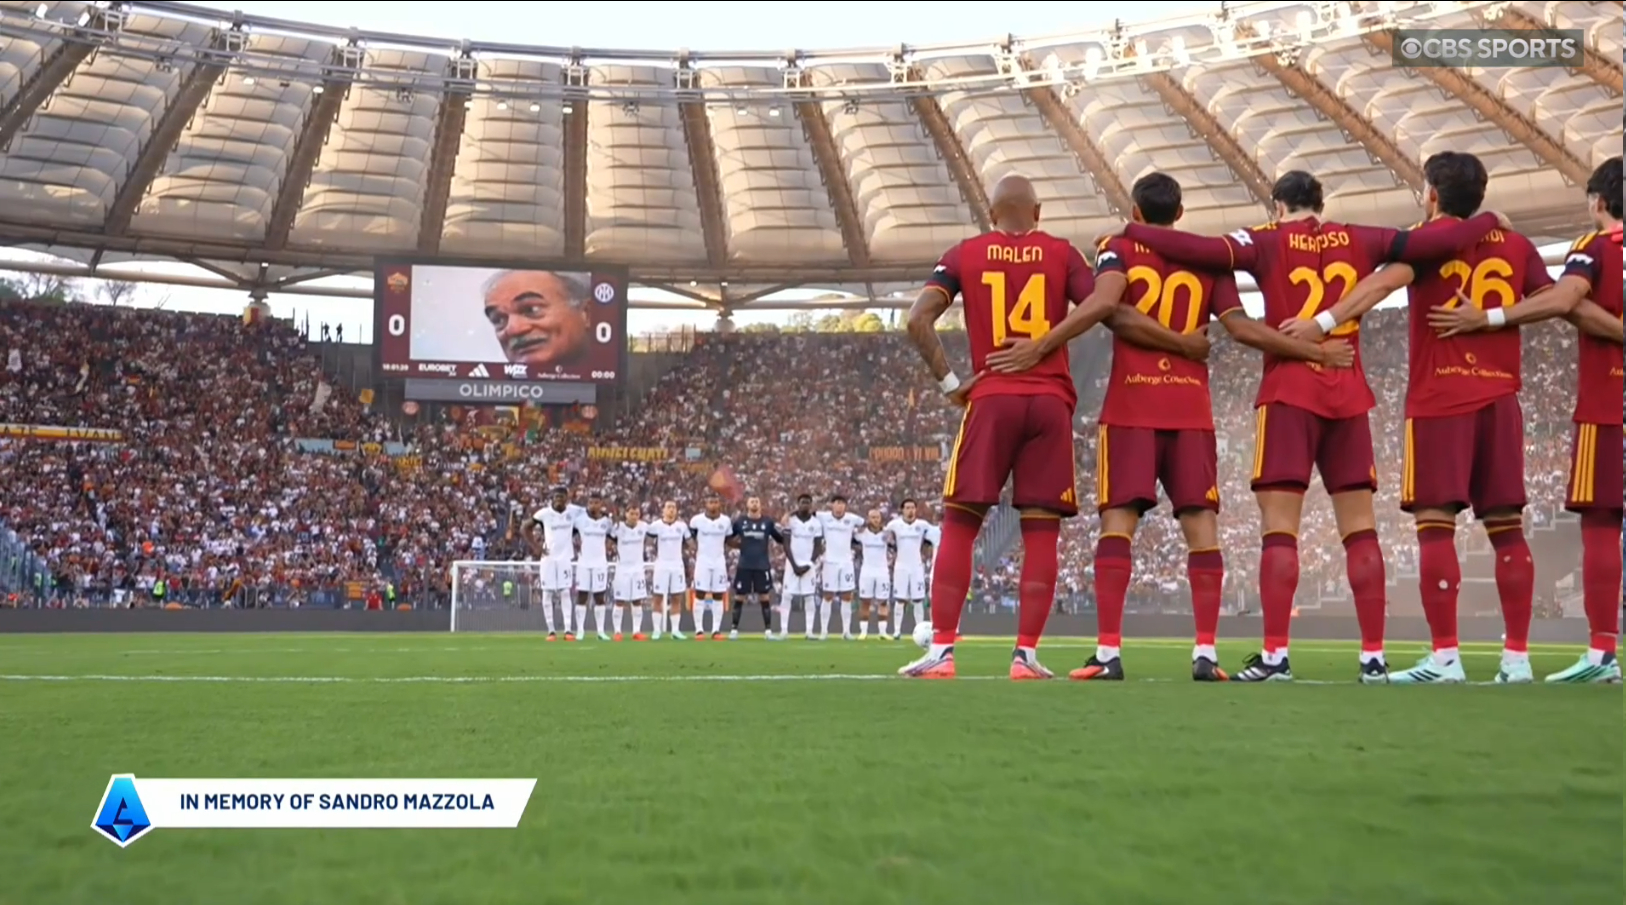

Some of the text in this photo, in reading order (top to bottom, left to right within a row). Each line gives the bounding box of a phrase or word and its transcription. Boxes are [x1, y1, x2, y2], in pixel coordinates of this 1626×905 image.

[987, 244, 1042, 263] MALEN
[1288, 261, 1360, 336] 22
[1439, 257, 1516, 318] 26
[981, 271, 1050, 347] 14
[1126, 265, 1203, 336] 20
[388, 314, 405, 336] 0
[595, 322, 612, 343] 0
[1124, 373, 1161, 385] Auberge
[459, 383, 543, 398] OLIMPICO
